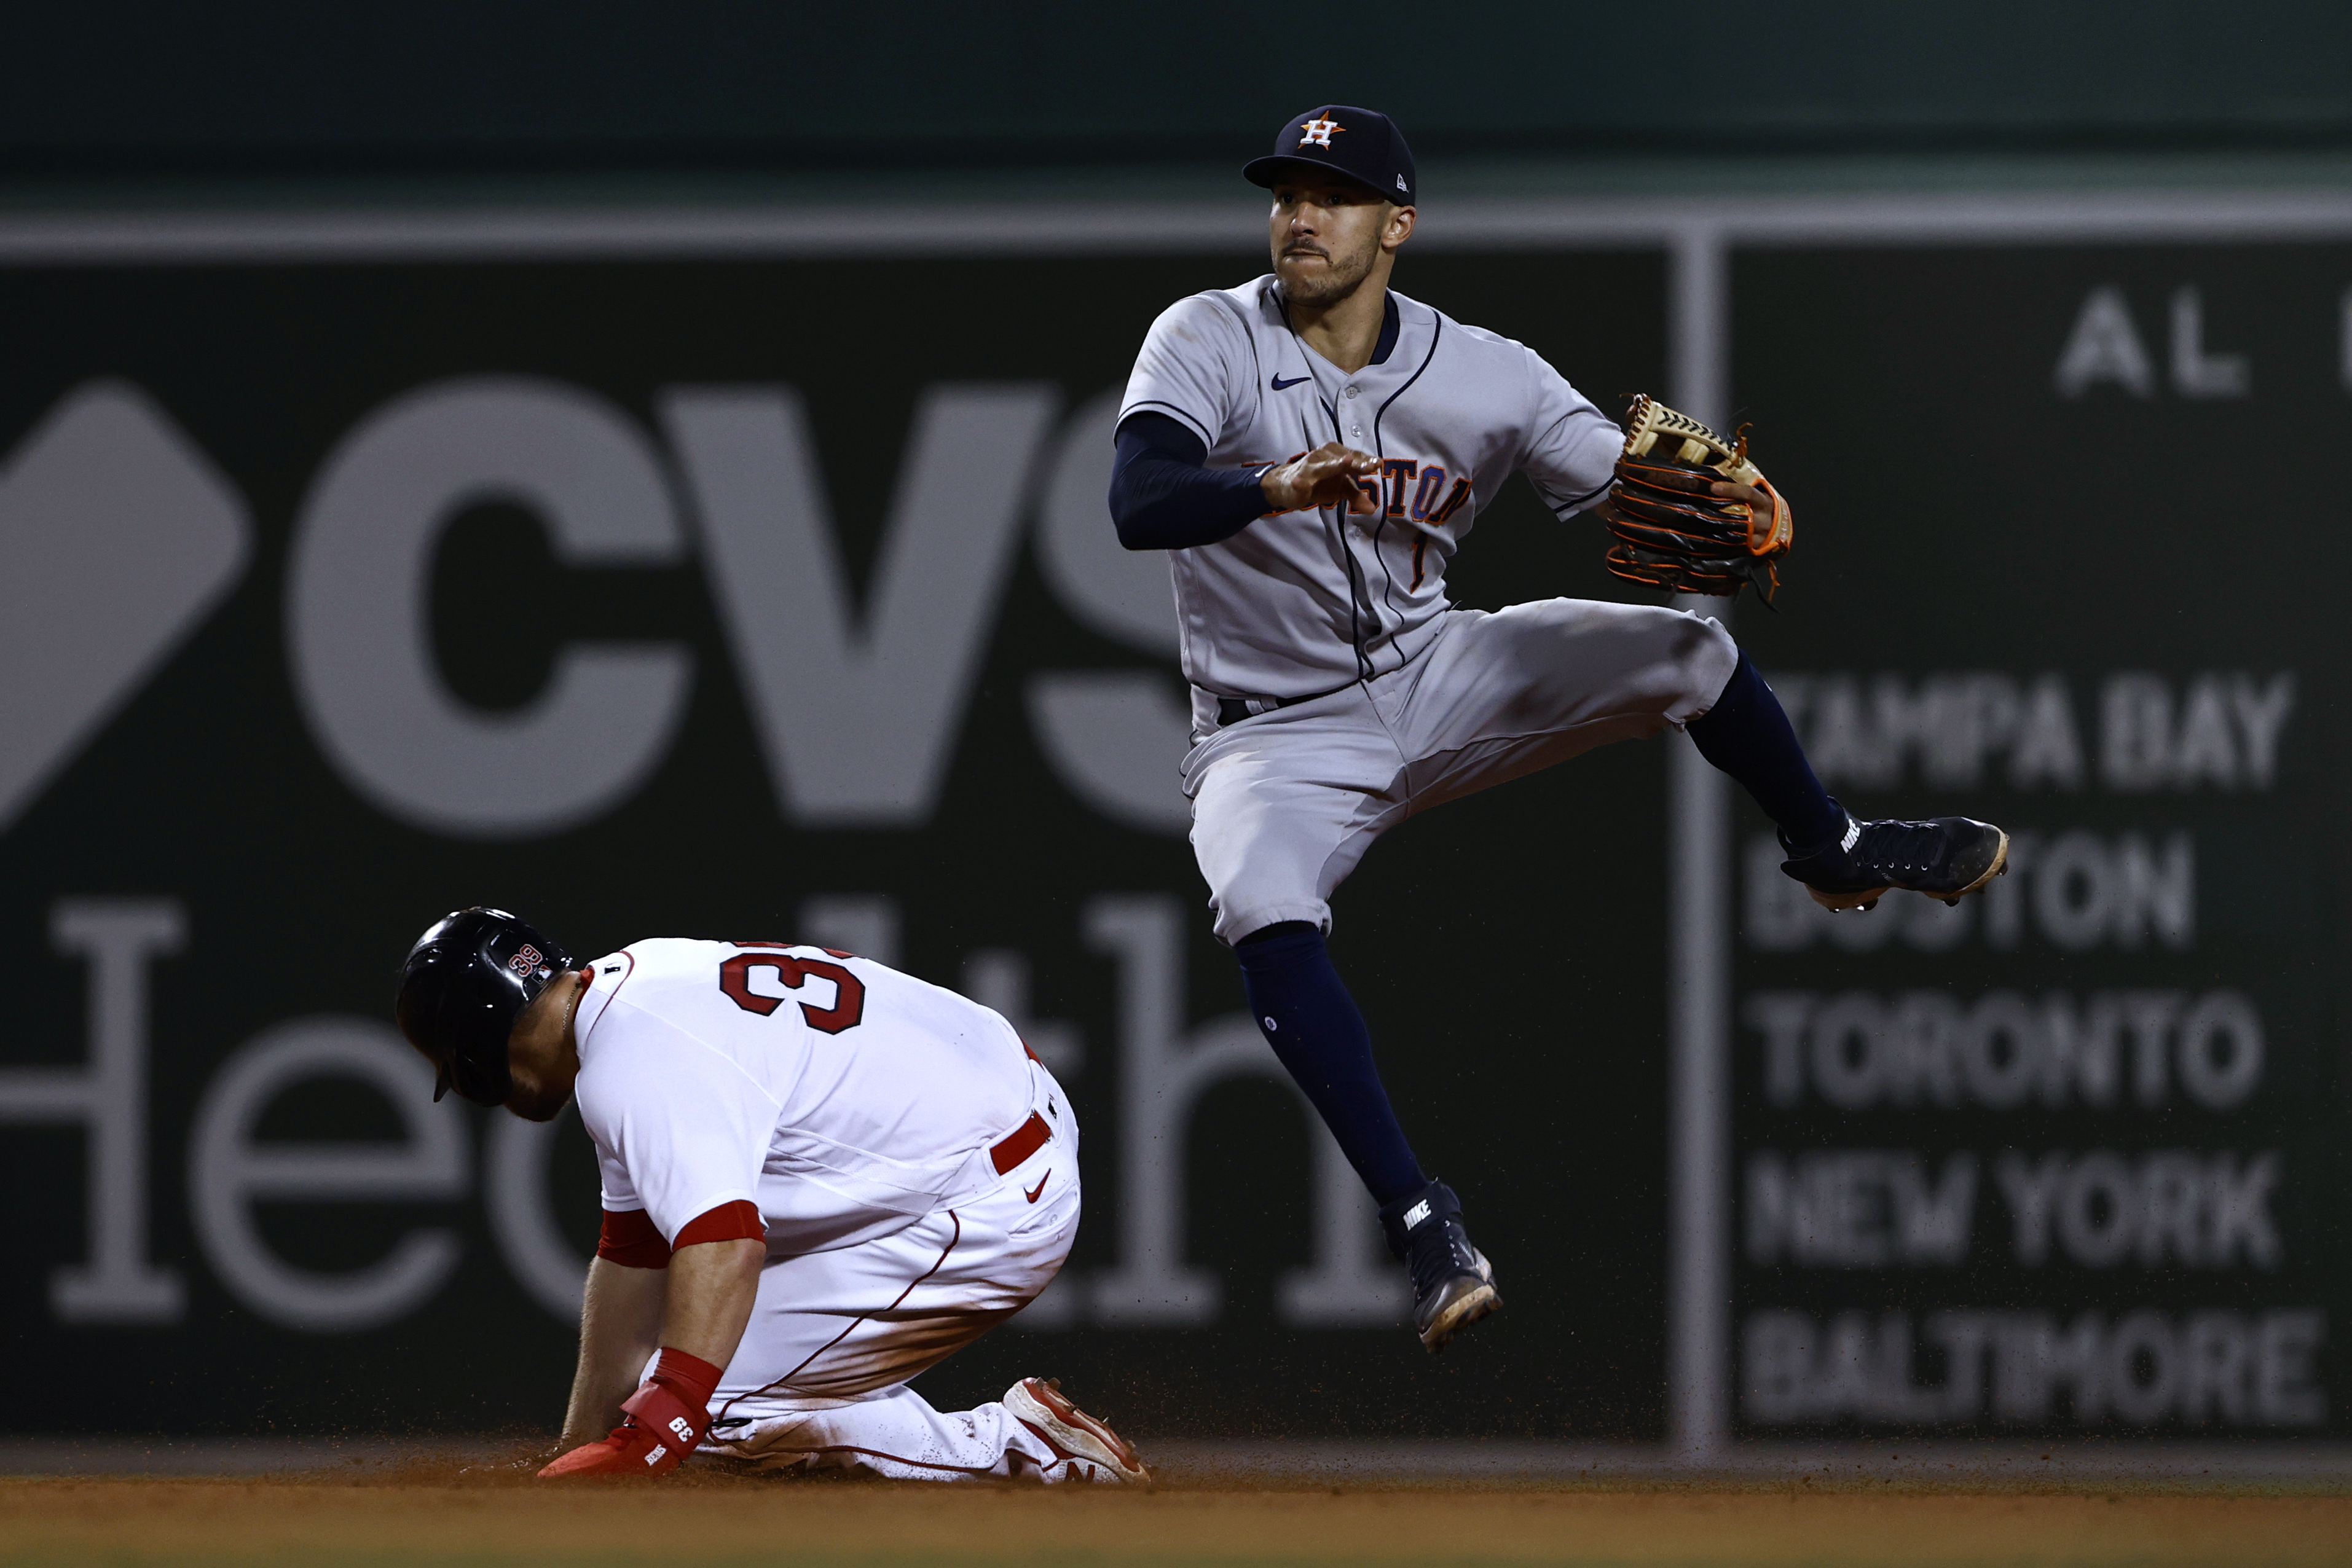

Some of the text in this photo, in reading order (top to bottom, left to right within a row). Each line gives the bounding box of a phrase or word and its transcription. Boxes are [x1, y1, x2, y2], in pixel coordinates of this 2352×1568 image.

[1300, 119, 1338, 145] H
[2051, 281, 2253, 401] AL
[1241, 452, 1473, 524] STON
[1410, 532, 1428, 594] 1
[2101, 670, 2297, 790] BAY
[1839, 818, 1861, 854] NIKE
[508, 943, 543, 978] 39
[720, 941, 867, 1035] 3
[1744, 990, 2265, 1107] TORONTO
[1402, 1199, 1431, 1231] NIKE
[1745, 1148, 2284, 1268] NEW YORK
[1744, 1306, 2327, 1425] BALTIMORE
[669, 1416, 694, 1443] 39
